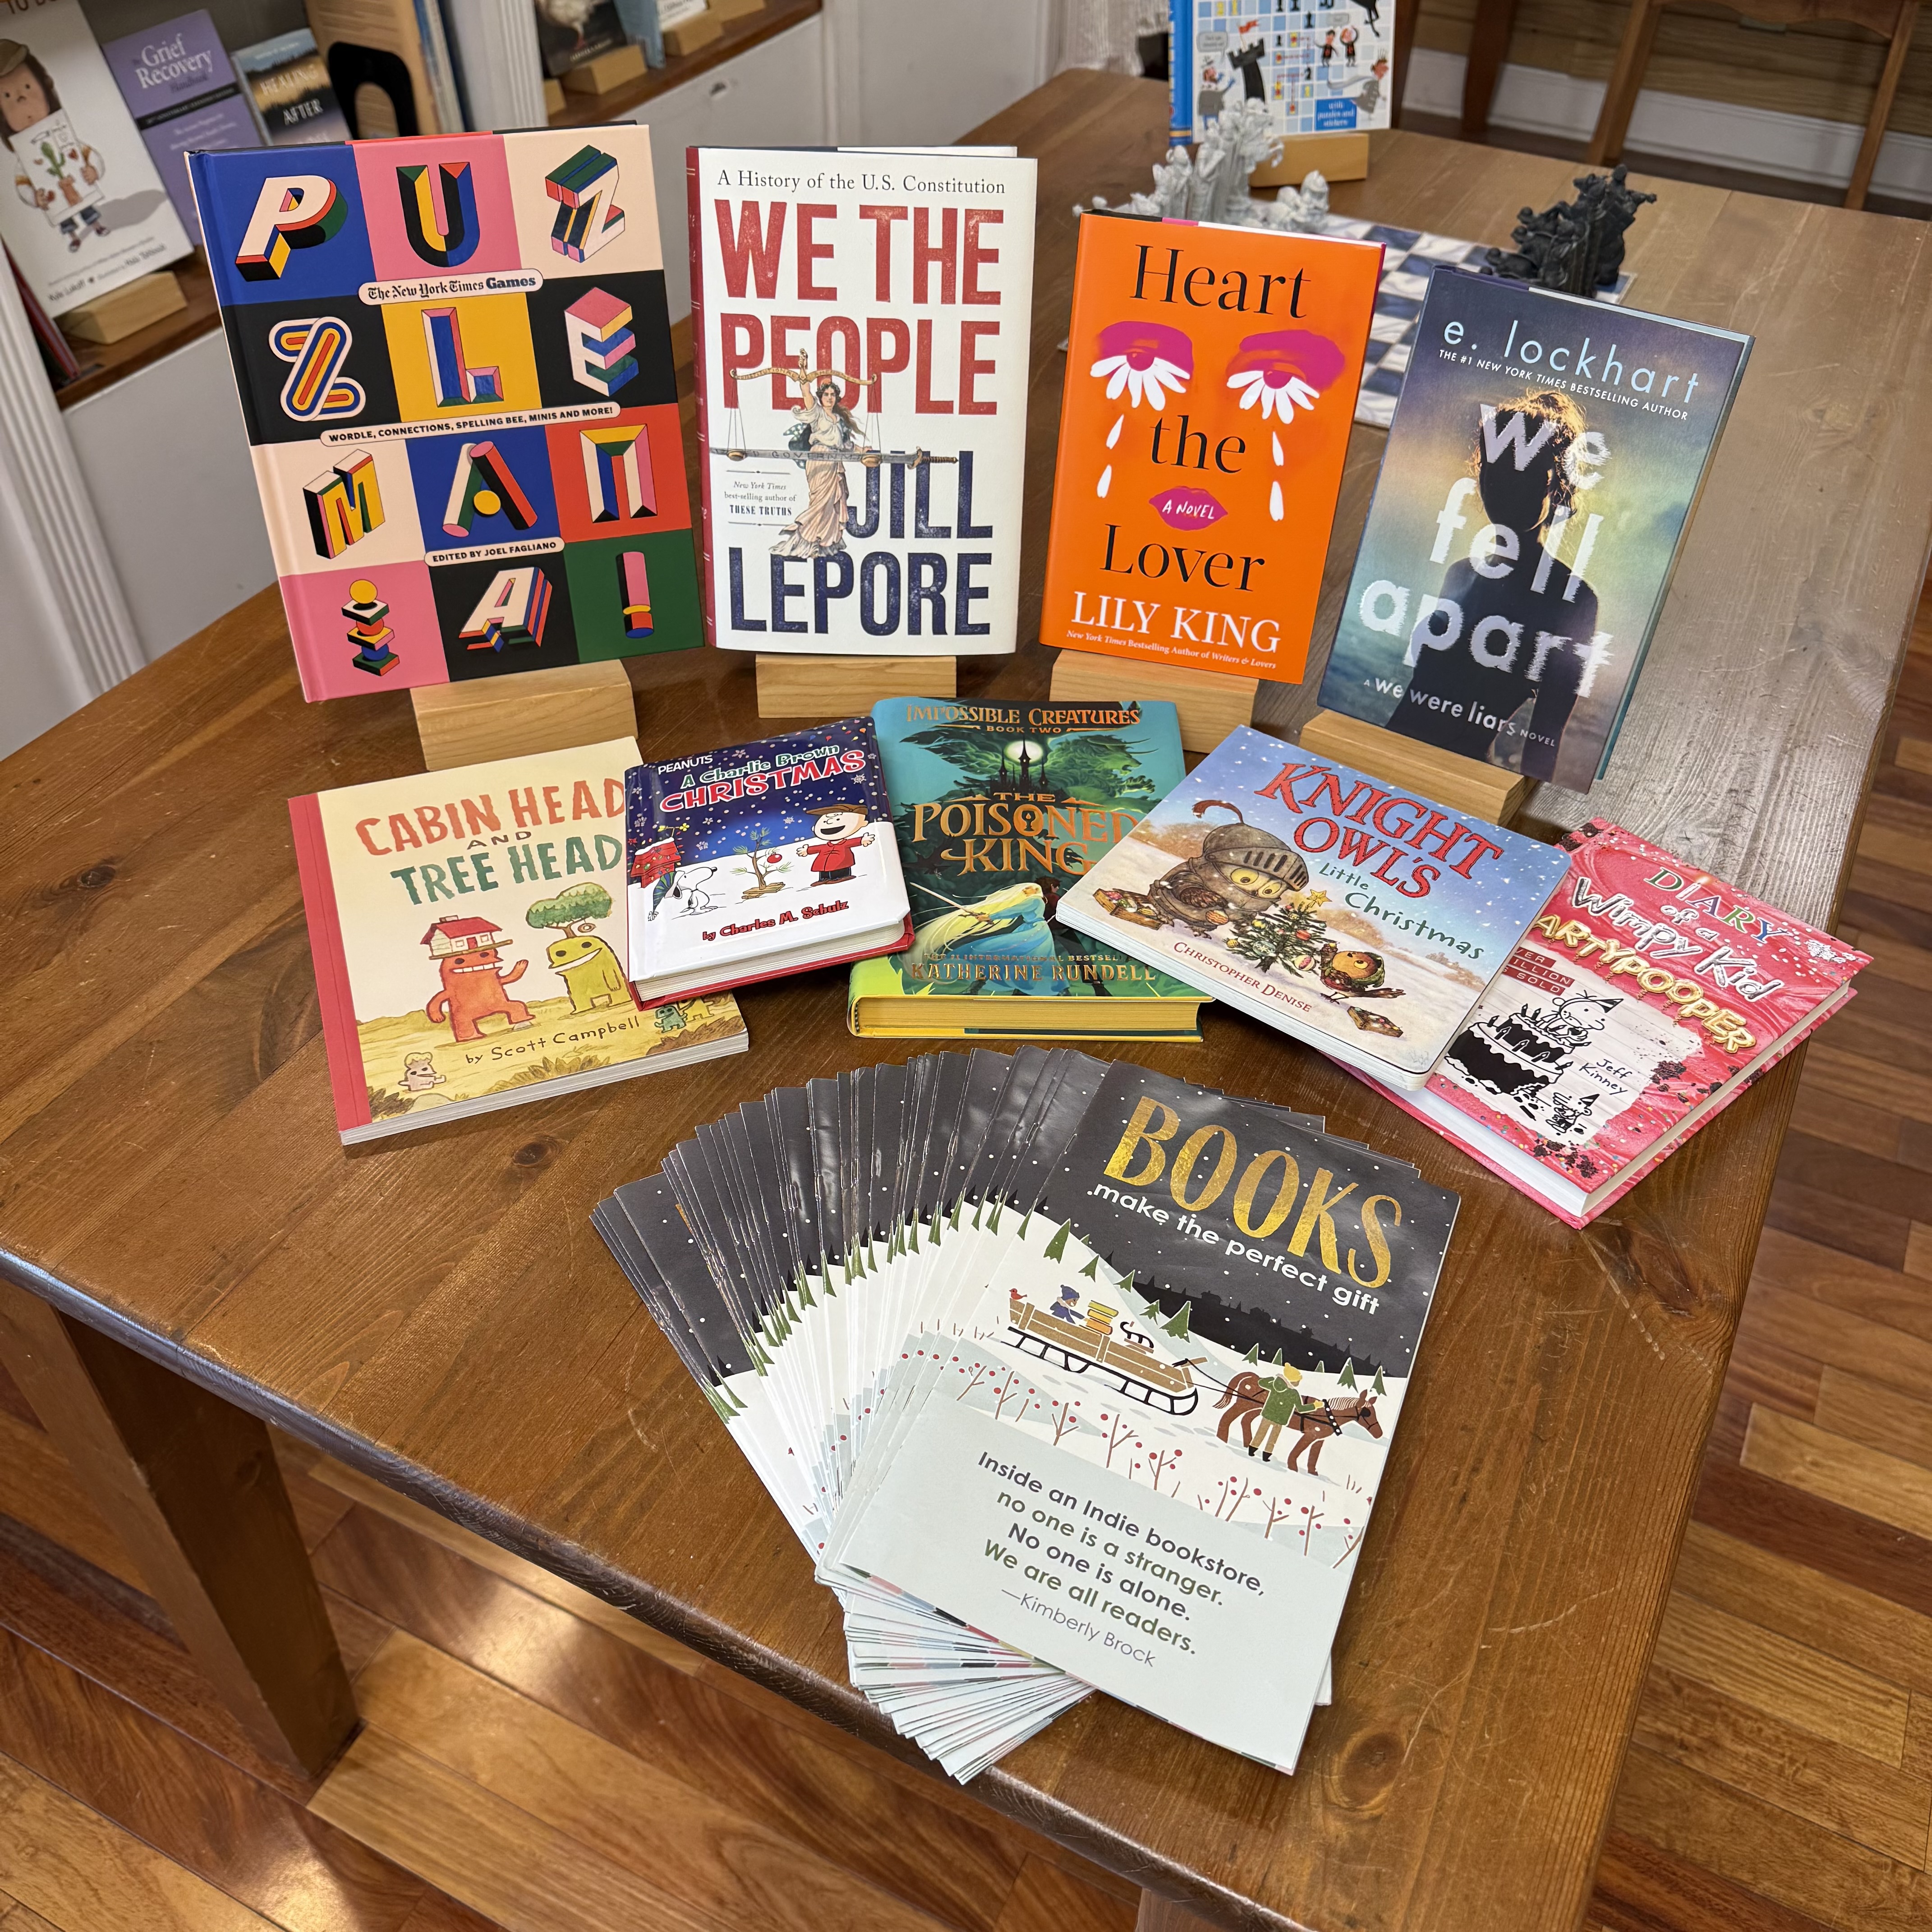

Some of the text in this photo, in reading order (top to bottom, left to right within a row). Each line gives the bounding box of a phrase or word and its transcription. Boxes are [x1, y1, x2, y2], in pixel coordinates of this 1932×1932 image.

[135, 50, 212, 89] Recovery
[141, 32, 186, 66] Grief
[283, 98, 324, 125] AFTER
[717, 170, 1005, 193] A History of the U.S. Constitution
[714, 199, 837, 301] WE
[859, 205, 1004, 305] THE
[1129, 244, 1311, 319] Heart
[368, 276, 536, 300] The New York Times Games
[720, 313, 1000, 415] PEOPLE
[1439, 349, 1688, 421] THE #1 NEW YORK TIMES BESTSELLING AUTHOR
[1444, 320, 1699, 404] e. lockhart
[329, 407, 613, 442] WORDLE, CONNECTIONS, SPELLING BEE, MINIS AND MORE!
[1150, 414, 1246, 474] the
[1480, 404, 1613, 491] we
[724, 491, 763, 502] best-selling
[730, 505, 792, 516] THESE TRUTHS
[846, 451, 993, 539] JILL
[1162, 499, 1214, 520] A NOVEL
[432, 552, 467, 562] EDITED
[485, 548, 507, 557] JOEL
[509, 542, 556, 553] FAGLIANO
[1099, 524, 1265, 592] Lover
[1430, 477, 1605, 603] fell
[729, 547, 992, 636] LEPORE
[1067, 630, 1084, 639] New
[1085, 632, 1103, 643] York
[1104, 635, 1127, 646] Times
[1128, 639, 1169, 655] Bestselling
[1171, 646, 1199, 658] Author
[1201, 651, 1211, 659] of
[1212, 652, 1240, 664] Writers
[1251, 658, 1276, 669] Lovers
[1071, 591, 1281, 653] LILY KING
[1358, 580, 1615, 699] apart
[906, 704, 1141, 727] IMPOSSIBLE CREATURES
[986, 725, 1062, 734] BOOK TWO
[1375, 678, 1404, 698] we
[1409, 689, 1463, 718] were
[1467, 701, 1516, 736] liars
[1519, 728, 1555, 747] NOVEL
[658, 754, 713, 774] PEANUTS
[659, 750, 866, 813] CHRISTMAS
[681, 745, 840, 789] A Charlie Brown
[355, 778, 625, 856] CABIN HEAD
[911, 801, 1140, 844] POISONED
[993, 792, 1056, 802] THE
[1254, 763, 1504, 879] KNIGHT
[390, 834, 622, 905] TREE HEAD
[467, 831, 532, 850] AND
[940, 838, 1098, 876] KING
[1293, 817, 1441, 899] OWL'S
[1319, 862, 1369, 890] Little
[1643, 866, 1790, 943] DIARY
[702, 900, 849, 941] by Charles M. Schulz
[1344, 892, 1484, 960] Christmas
[1571, 875, 1785, 1002] Wimpy Kid
[1661, 903, 1720, 942] of a
[911, 963, 1156, 981] KATHERINE RUNDELL
[1174, 942, 1312, 1012] CHRISTOPHER DENISE
[1513, 959, 1570, 984] ILLION
[1517, 973, 1560, 993] SOLD
[1534, 914, 1757, 1053] ARTYPOOPER
[465, 1015, 640, 1065] by Scott Campbell
[1596, 1059, 1633, 1078] Jeff
[1579, 1063, 1628, 1095] Kinney
[1104, 1096, 1402, 1288] BOOKS
[1093, 1183, 1380, 1315] make the perfect gift
[978, 1451, 1264, 1596] Inside an Indie bookstore,
[997, 1492, 1223, 1605] no one is a stranger.
[984, 1539, 1195, 1654] We are all readers.
[1007, 1523, 1189, 1621] No one is alone.
[1104, 1632, 1155, 1667] Brock
